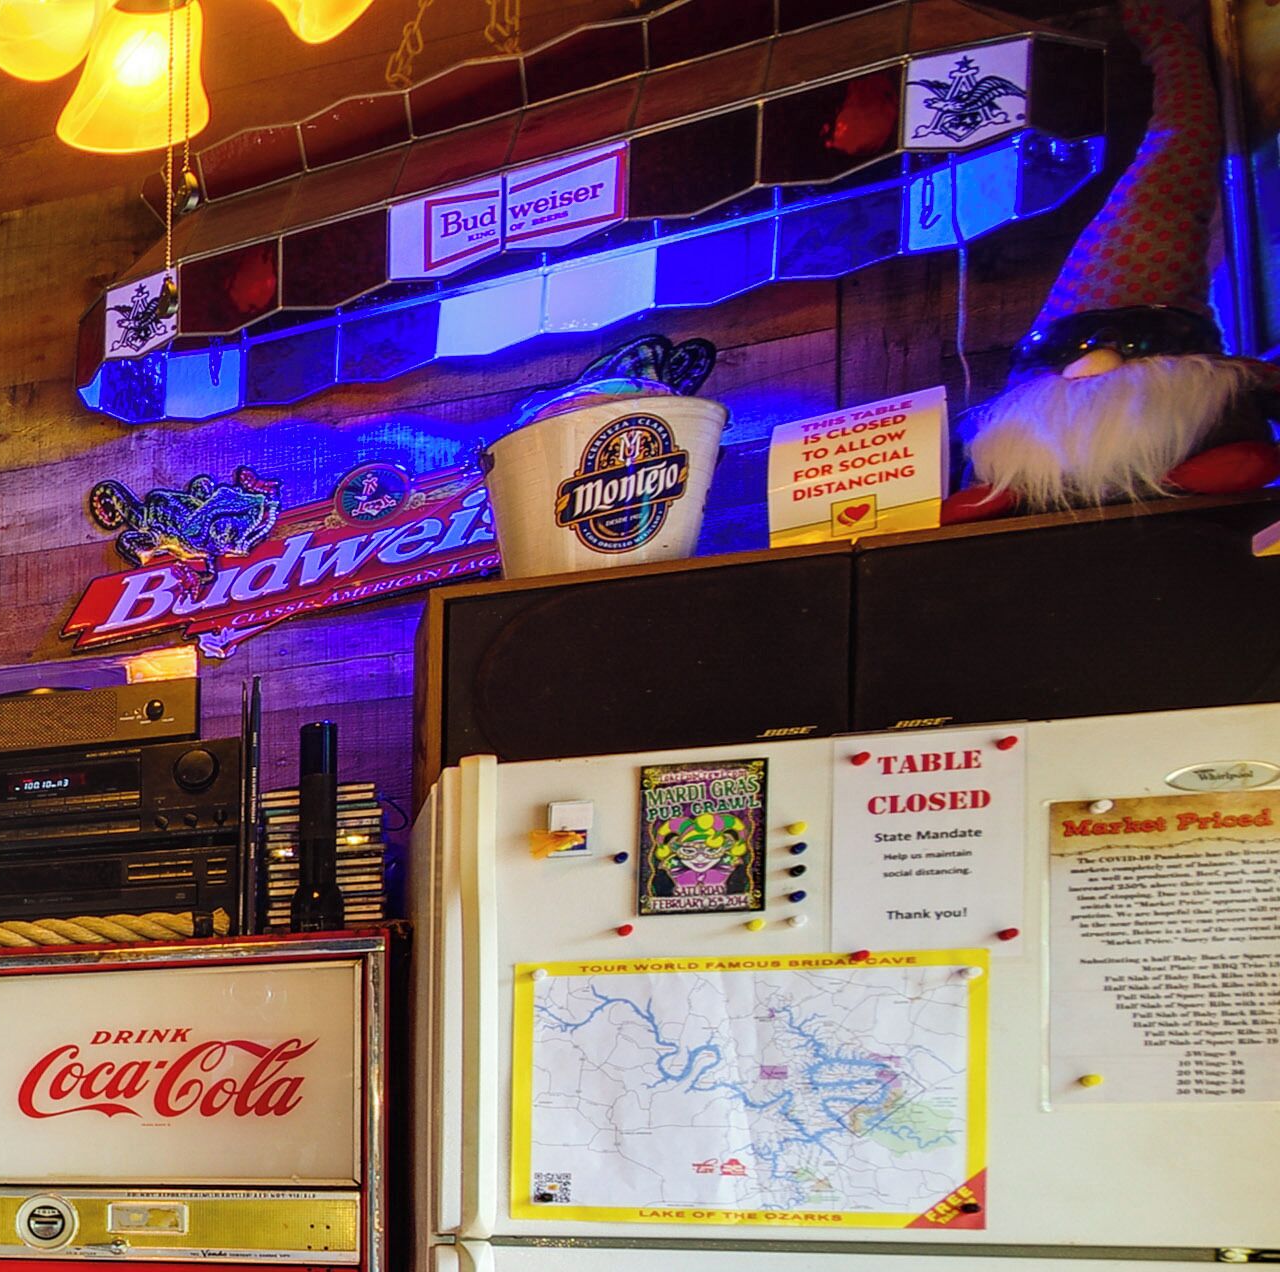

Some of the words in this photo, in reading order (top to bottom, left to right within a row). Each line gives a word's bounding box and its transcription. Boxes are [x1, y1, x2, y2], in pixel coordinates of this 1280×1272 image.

[801, 415, 846, 433] THIS
[851, 400, 914, 421] TABLE
[803, 433, 822, 446] IS
[826, 414, 907, 440] CLOSED
[587, 420, 630, 462] CERVEZA
[637, 418, 669, 441] CLARA
[802, 447, 829, 462] TO
[834, 429, 907, 455] ALLOW
[793, 463, 833, 483] FOR
[838, 446, 915, 473] SOCIAL
[571, 461, 679, 518] Montejo
[792, 465, 916, 502] DISTANCING
[326, 569, 443, 605] AMERICAN
[763, 726, 812, 737] BOSE
[895, 717, 946, 729] BOSE
[877, 749, 983, 776] TABLE
[646, 783, 707, 808] MARDI
[711, 774, 761, 800] GRAS
[867, 789, 992, 816] CLOSED
[646, 802, 684, 822] PUB
[691, 795, 762, 817] CRAWL
[874, 831, 913, 844] State
[915, 828, 984, 841] Mandate
[1062, 815, 1168, 837] Market
[1175, 808, 1274, 832] Priced
[883, 852, 909, 862] Help
[910, 852, 923, 860] us
[925, 849, 973, 860] maintain
[1097, 855, 1152, 864] COVID-19
[883, 868, 913, 879] social
[915, 865, 973, 879] distancing.
[651, 896, 707, 912] FEBRUARY
[673, 884, 727, 898] SATURDAY
[886, 908, 931, 921] Thank
[934, 907, 968, 921] you!
[579, 962, 628, 973] TOUR
[633, 961, 700, 973] WORLD
[705, 959, 782, 970] FAMOUS
[787, 957, 859, 968] BRIDAL
[864, 955, 918, 966] CAVE
[90, 1027, 194, 1046] DRINK
[18, 1037, 321, 1119] Coca-Cola
[638, 1209, 687, 1220] LAKE
[692, 1210, 716, 1220] OF
[722, 1211, 759, 1222] THE
[766, 1212, 844, 1223] OZARKS
[924, 1186, 975, 1223] FREE
